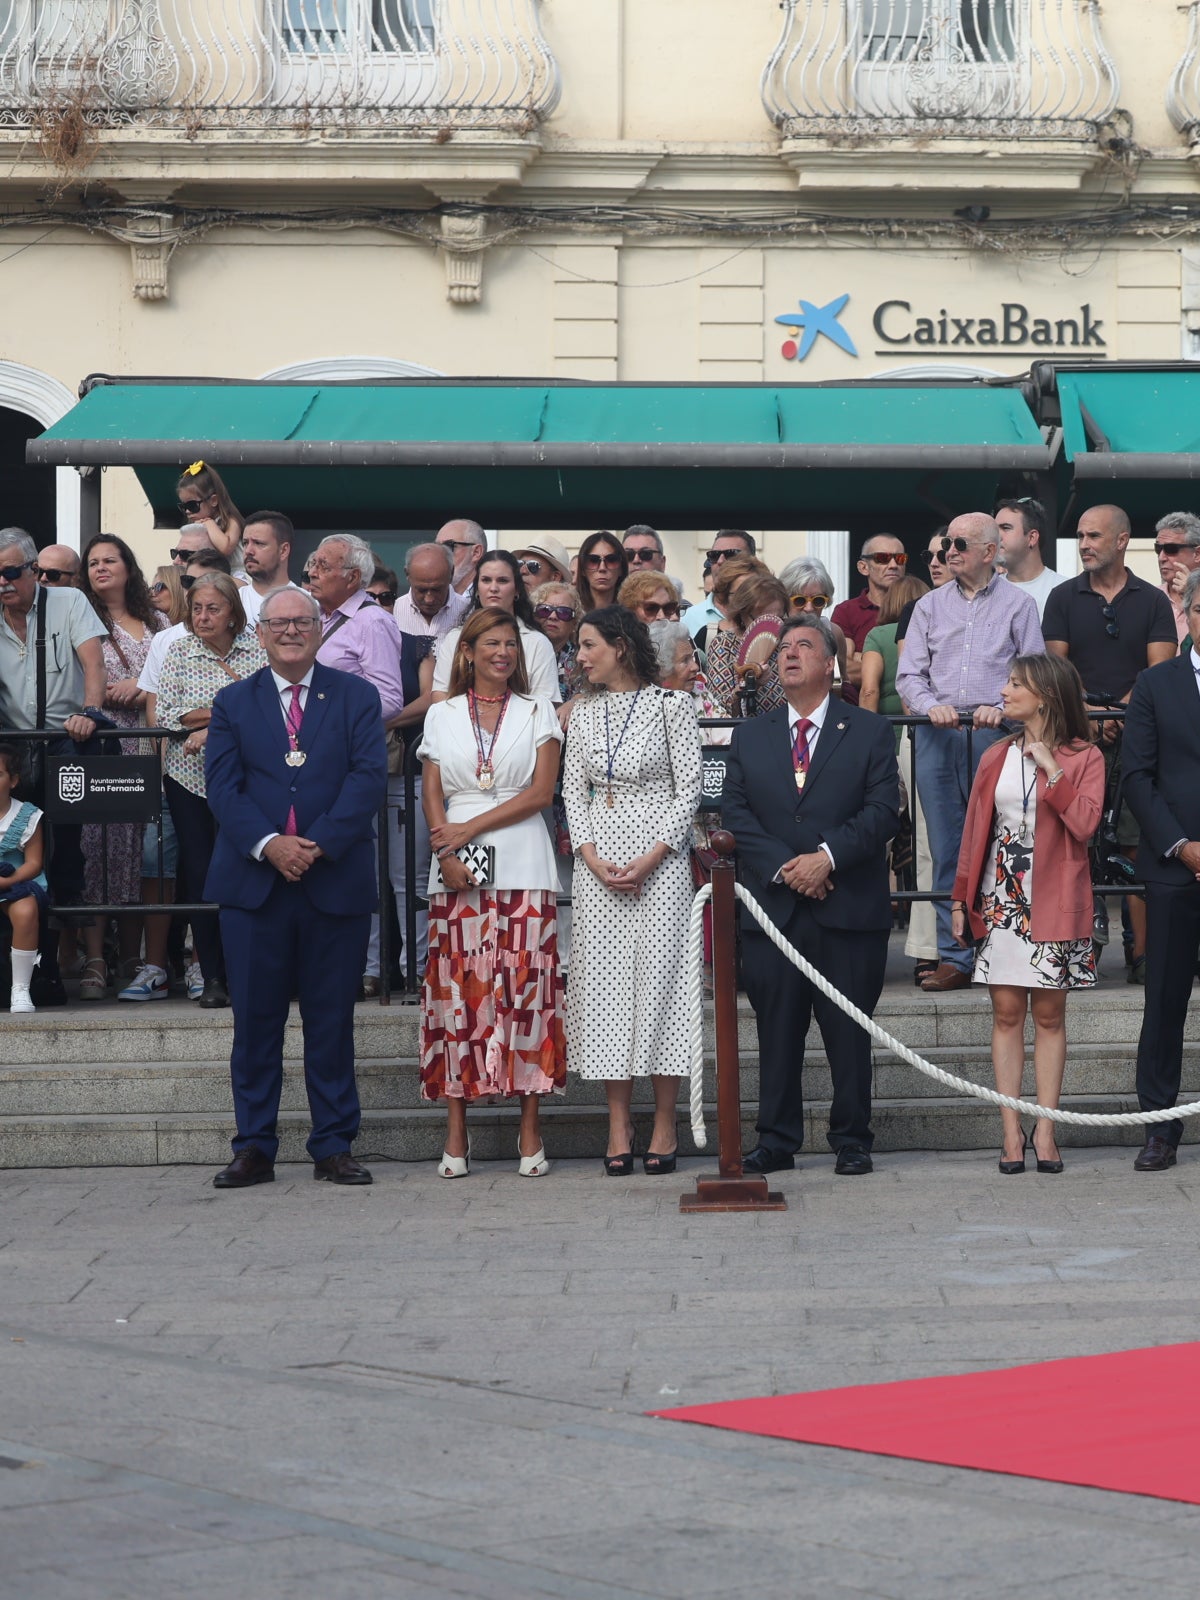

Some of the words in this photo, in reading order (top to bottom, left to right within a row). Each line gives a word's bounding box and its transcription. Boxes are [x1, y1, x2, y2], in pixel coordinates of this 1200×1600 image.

[873, 299, 1106, 346] CaixaBank
[703, 770, 723, 779] SAN
[62, 776, 81, 784] SAN
[90, 778, 135, 786] Ayuntamiento
